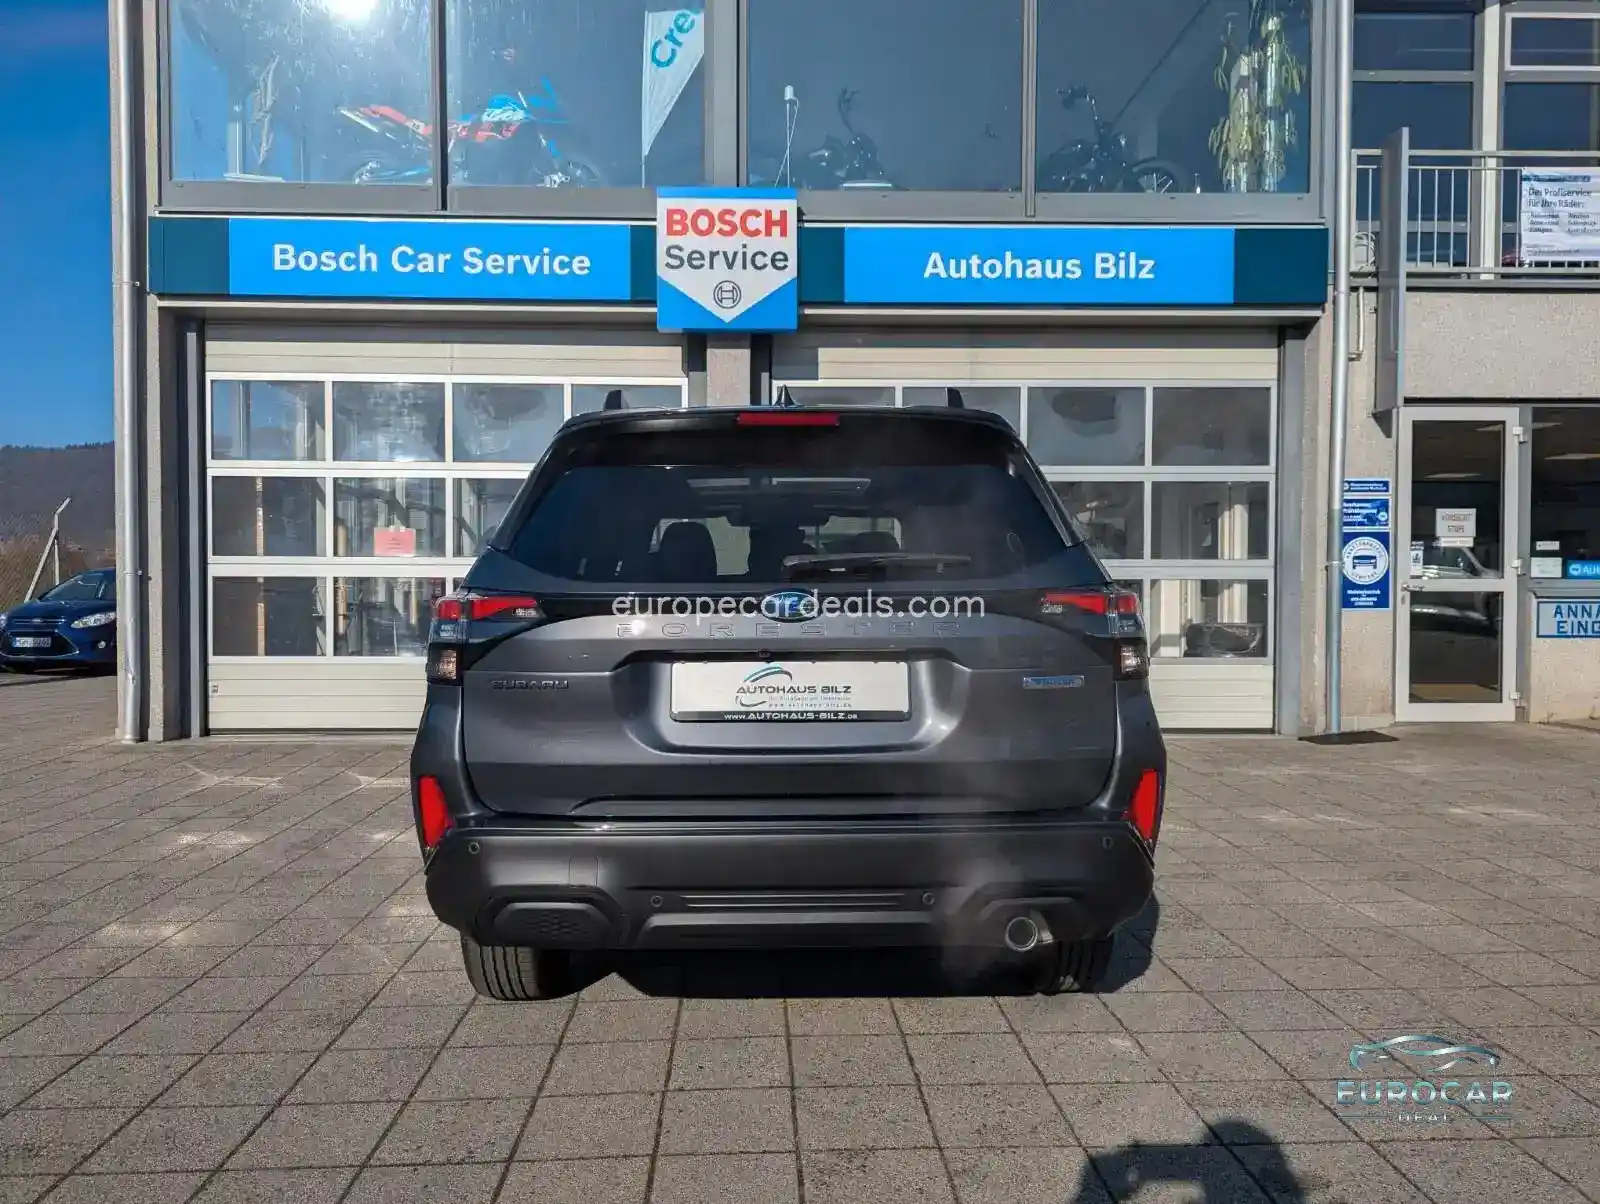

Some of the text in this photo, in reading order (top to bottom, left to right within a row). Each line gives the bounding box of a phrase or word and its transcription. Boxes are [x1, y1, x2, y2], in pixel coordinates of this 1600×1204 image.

[665, 208, 788, 238] BOSCH
[272, 243, 591, 276] Bosch Car Service
[664, 242, 789, 272] Service
[923, 251, 1156, 280] Autohaus Bilz
[616, 621, 961, 638] FORESTER
[488, 679, 569, 690] SUBARU
[736, 685, 852, 695] AUTOHAUS BILZ
